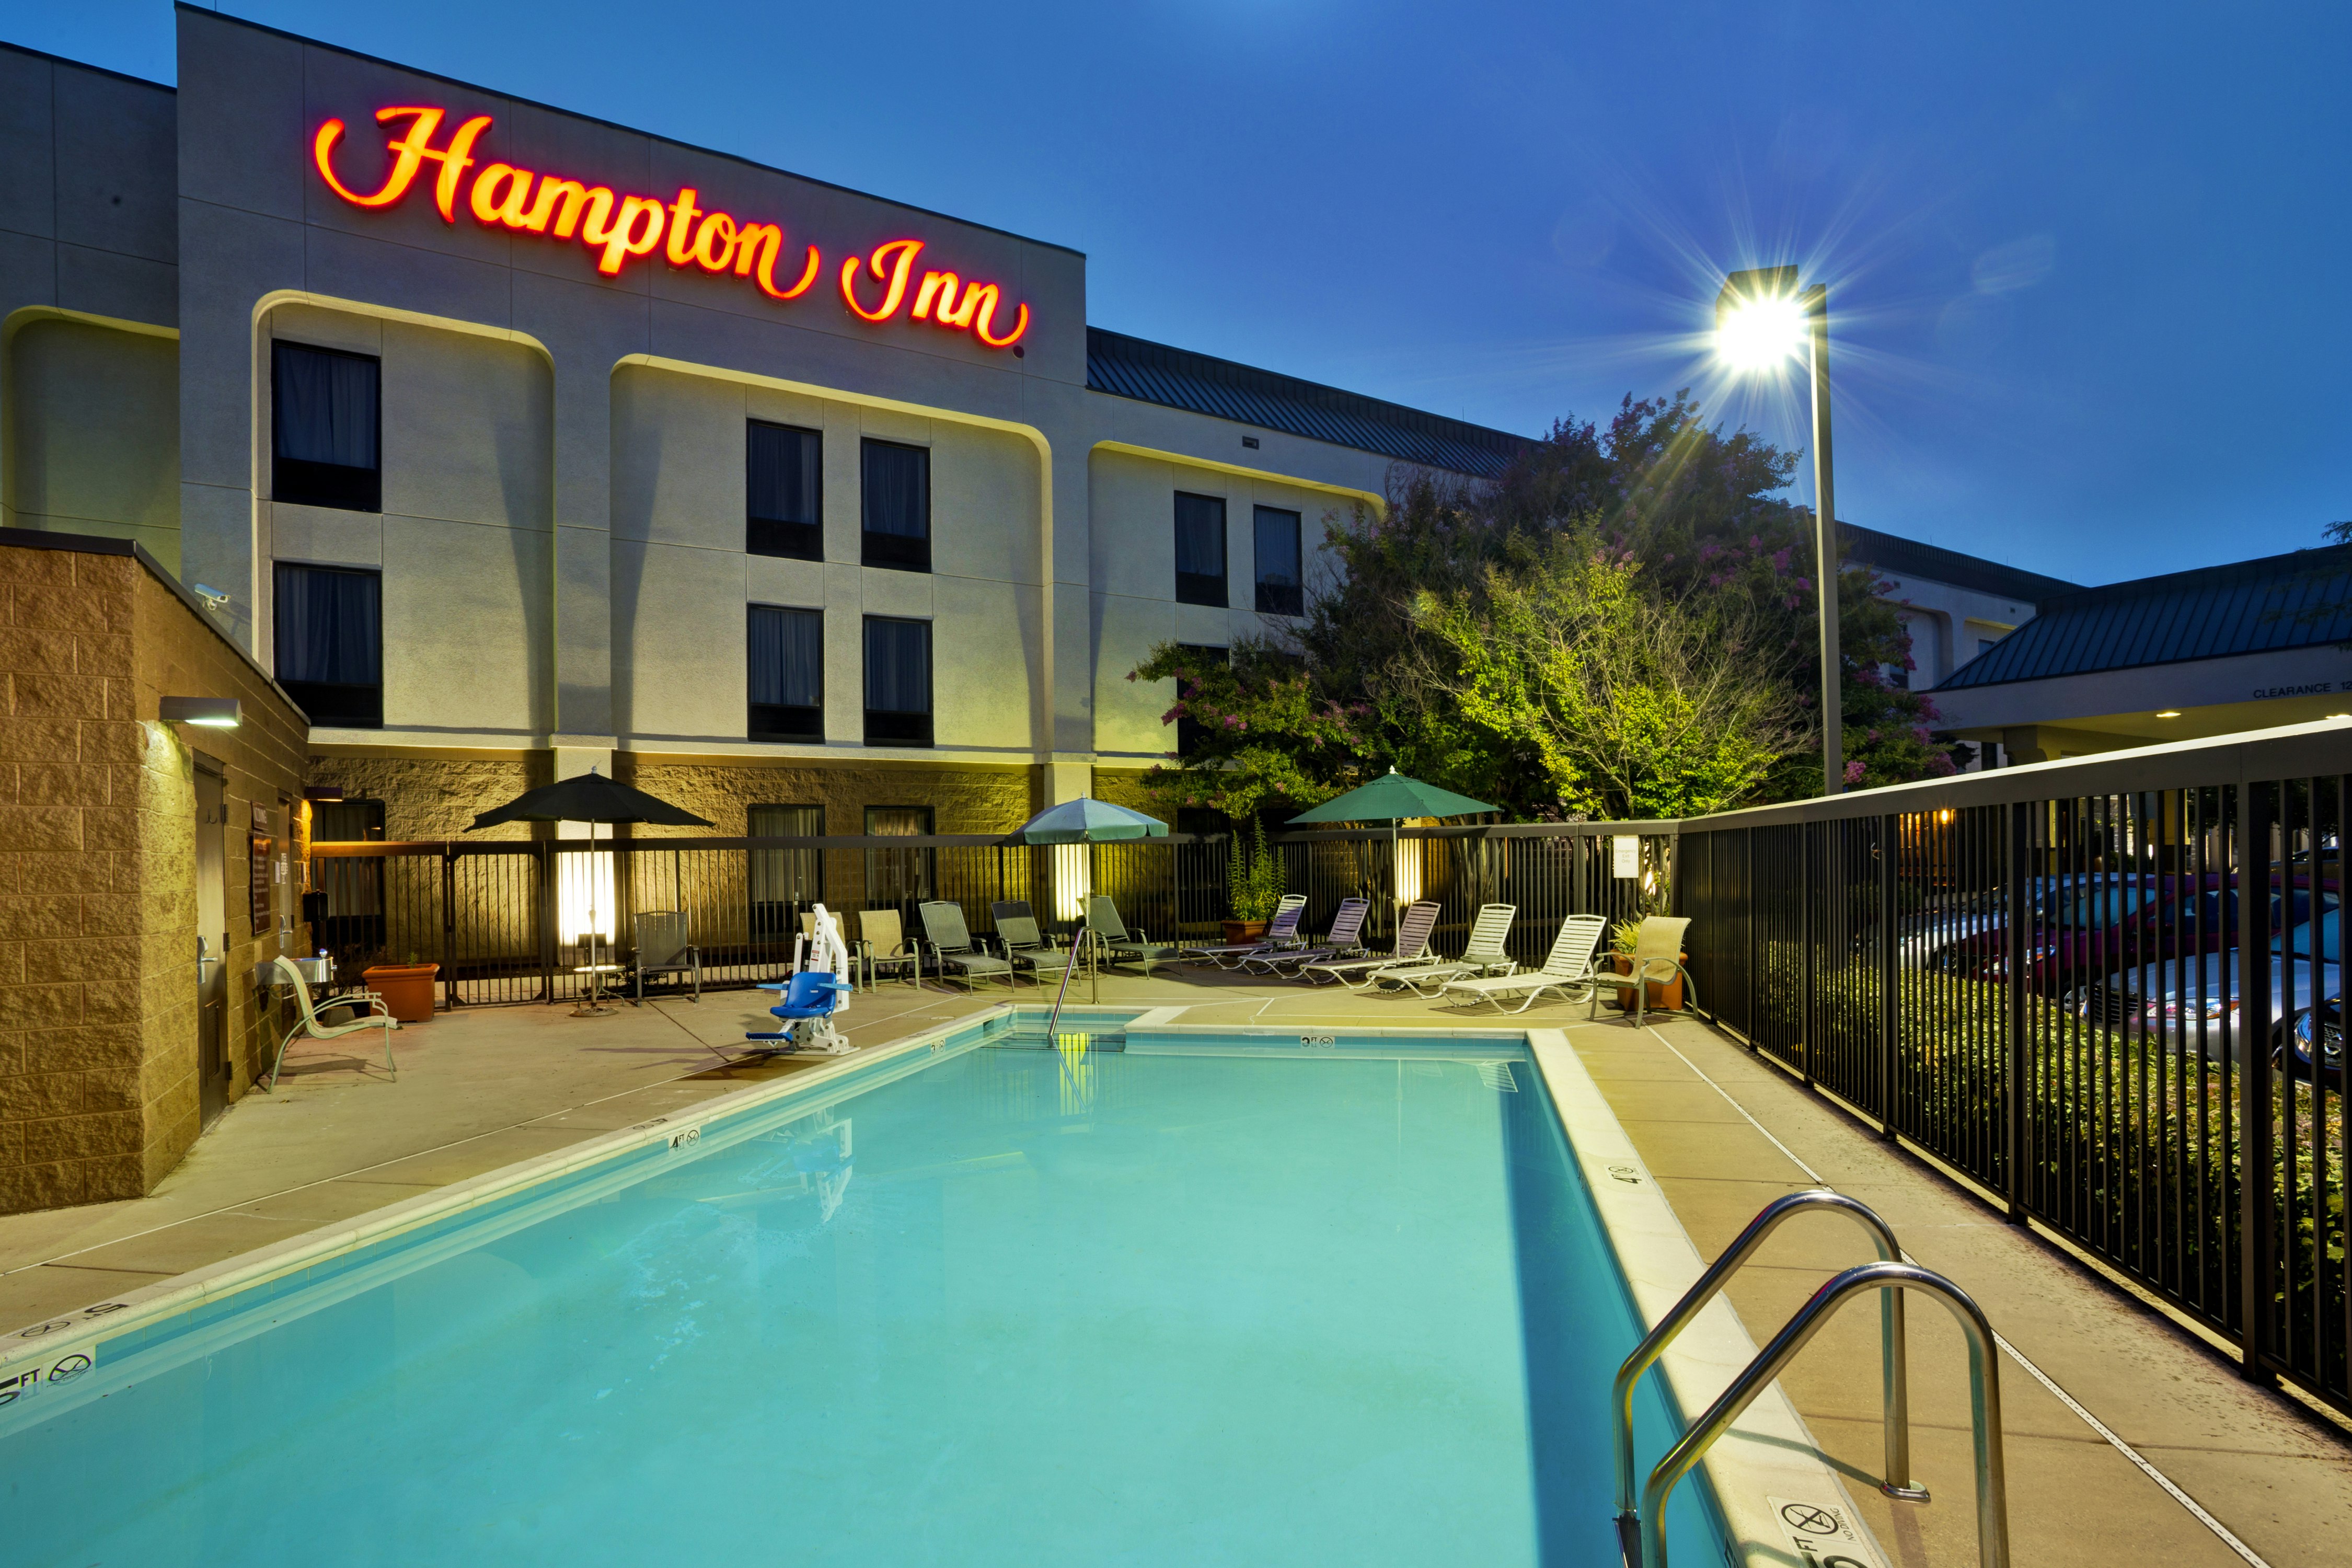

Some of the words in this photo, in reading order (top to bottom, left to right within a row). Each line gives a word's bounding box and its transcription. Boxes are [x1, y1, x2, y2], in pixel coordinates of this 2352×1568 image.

[315, 106, 821, 299] Hampton
[840, 239, 1030, 348] Inn
[2253, 683, 2331, 698] CLEARANCE
[21, 1368, 40, 1388] FT
[1829, 1507, 1850, 1529] DIVING
[1792, 1536, 1818, 1552] FT
[1843, 1530, 1857, 1541] NO
